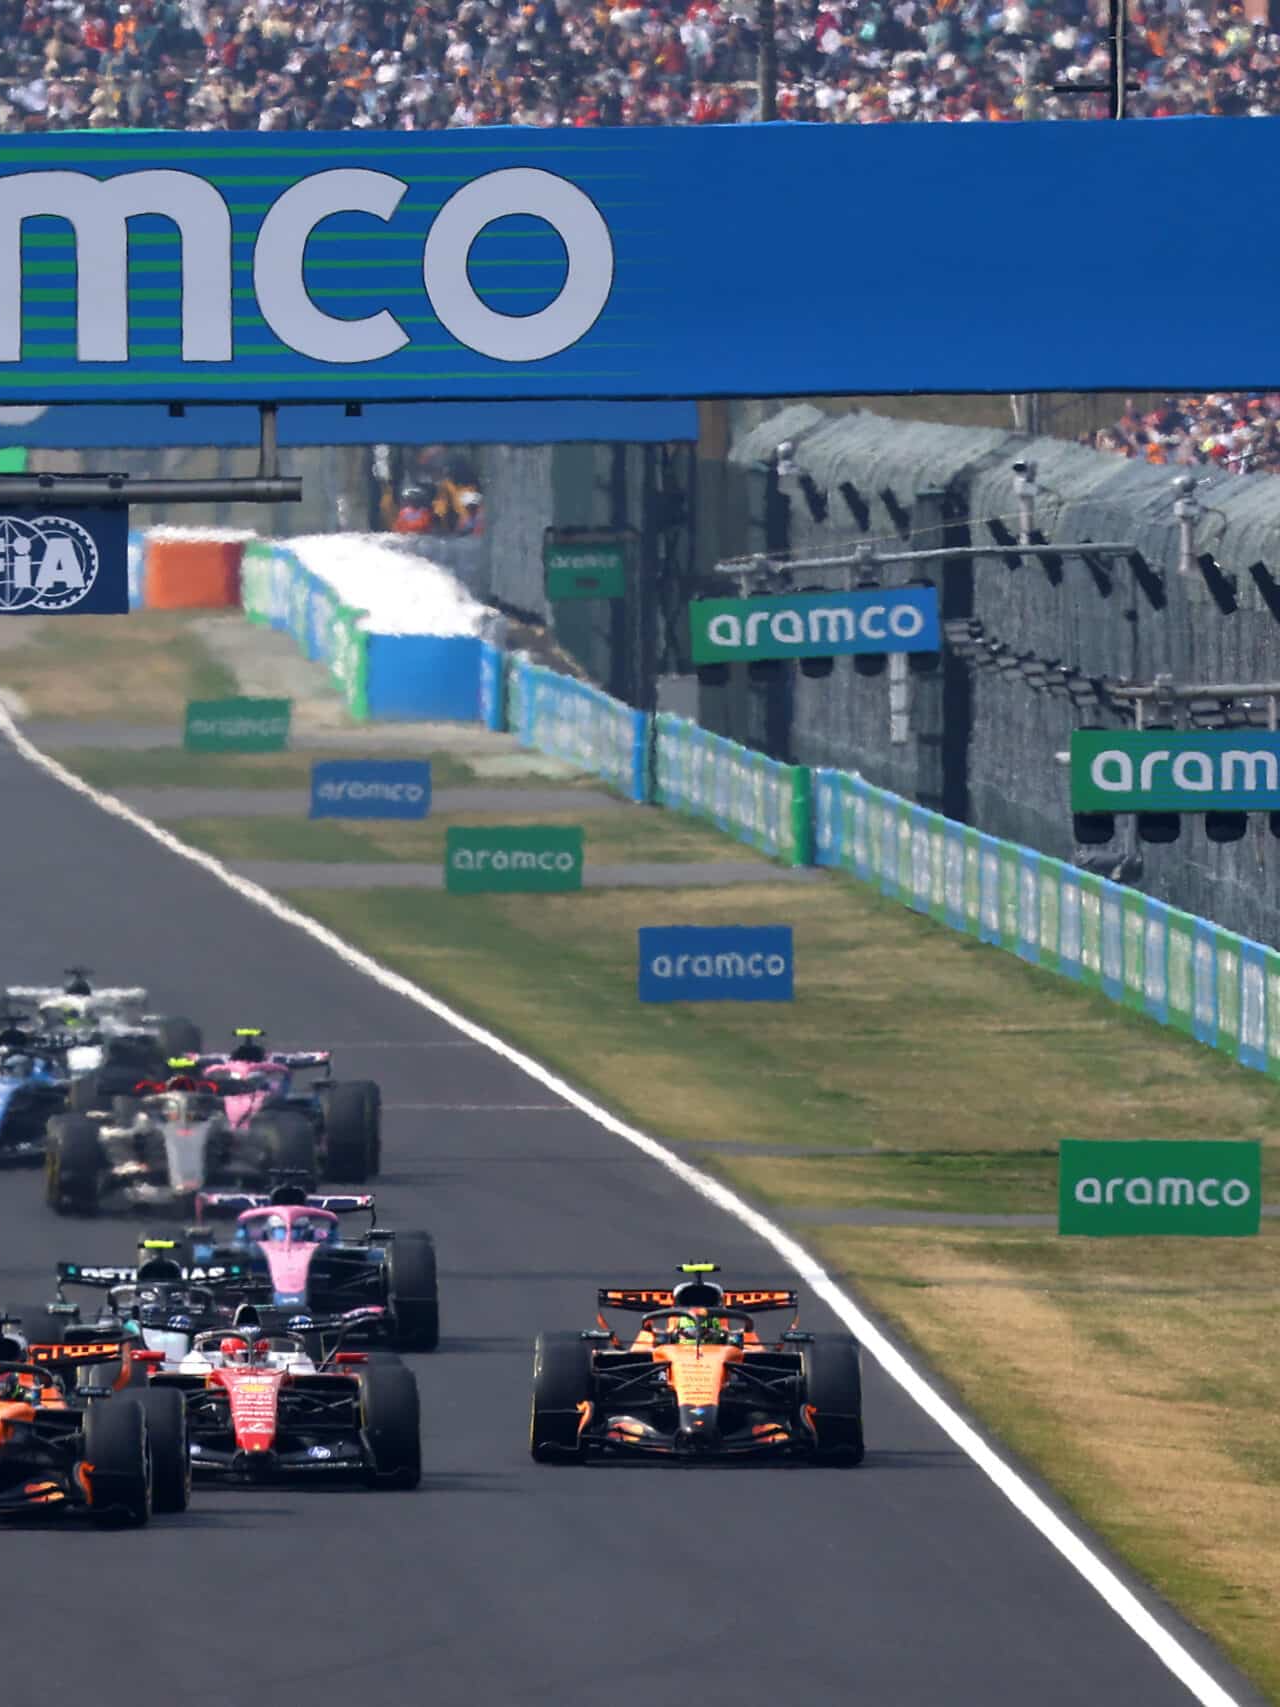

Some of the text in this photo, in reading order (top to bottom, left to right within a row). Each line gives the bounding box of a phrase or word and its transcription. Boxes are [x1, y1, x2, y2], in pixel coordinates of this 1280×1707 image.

[708, 603, 923, 647] aramco
[318, 780, 424, 802] aramco
[453, 848, 575, 872] aramco
[652, 953, 785, 978] aramco
[1075, 1177, 1251, 1207] aramco
